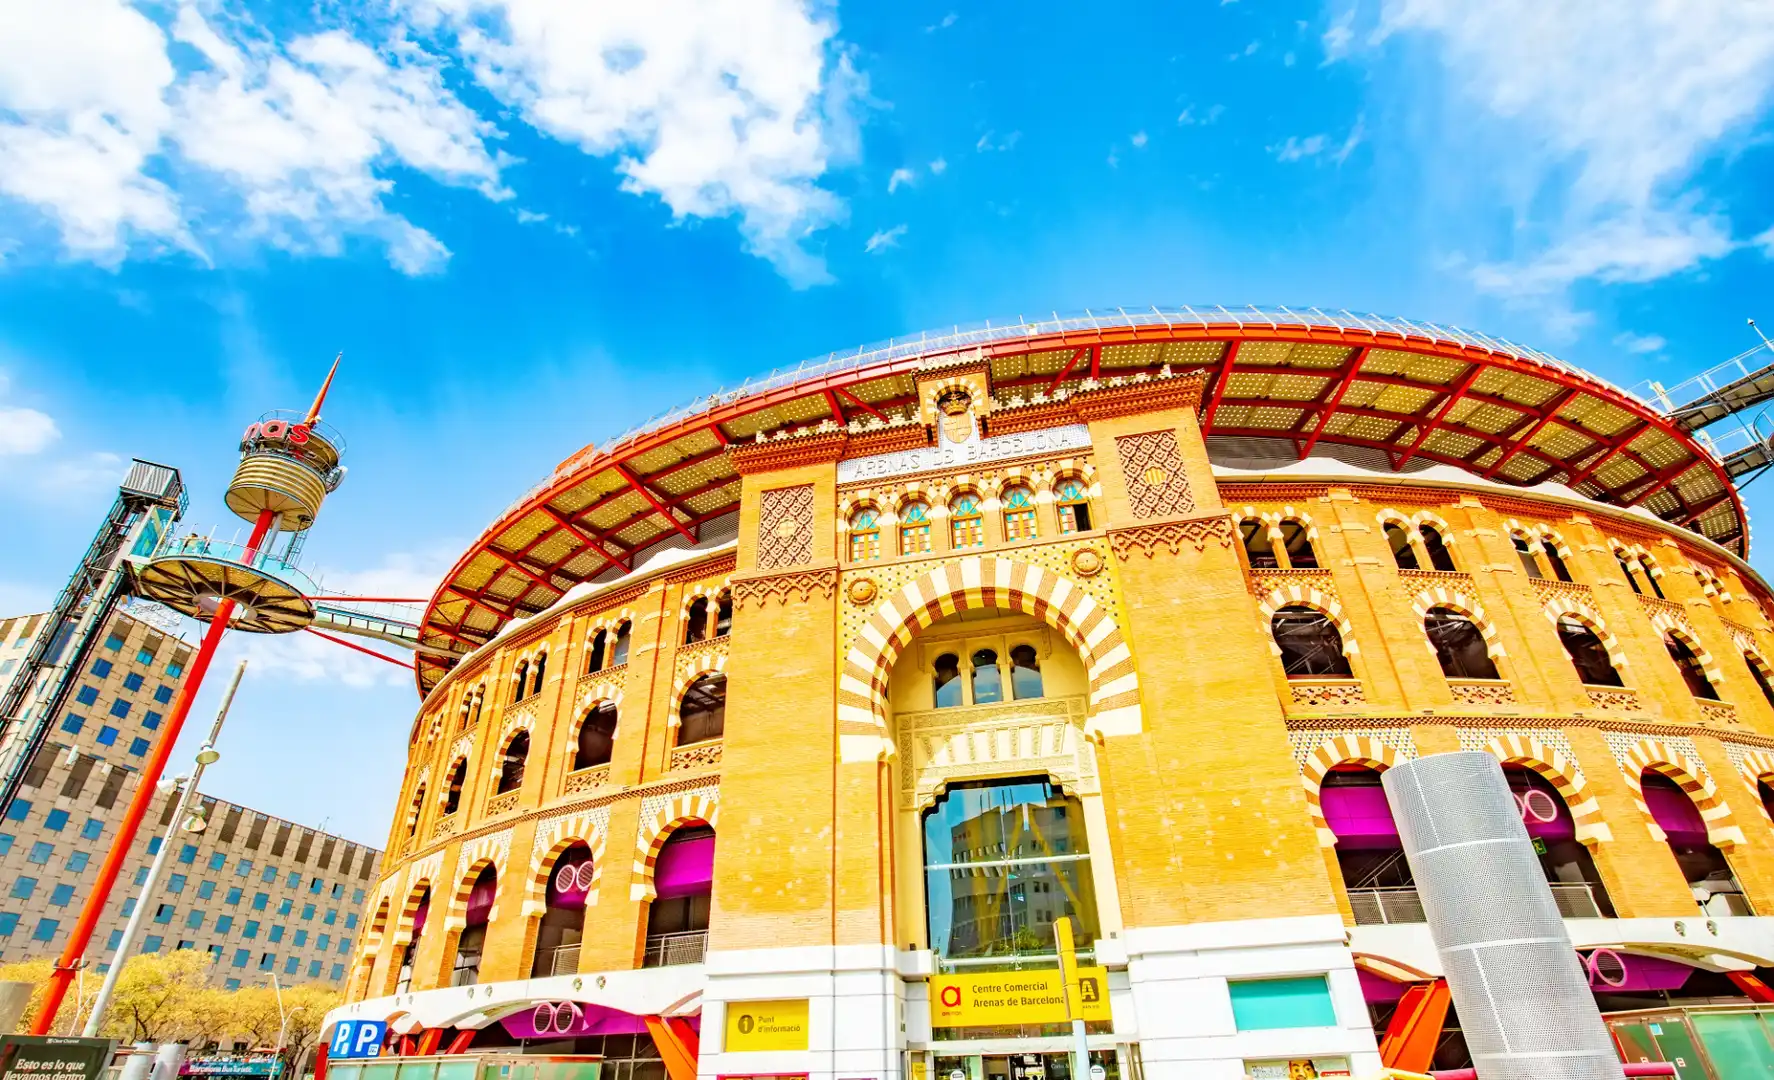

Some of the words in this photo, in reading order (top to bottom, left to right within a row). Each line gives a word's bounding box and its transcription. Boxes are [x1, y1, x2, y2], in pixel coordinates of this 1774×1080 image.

[854, 454, 920, 478] ARENAS
[933, 449, 954, 466] DE
[967, 433, 1072, 462] BARCELONA
[972, 984, 1002, 994] Centre
[1004, 982, 1048, 992] Comercial
[973, 998, 1005, 1008] Arenas
[1007, 997, 1018, 1007] de
[333, 1023, 351, 1052] P
[355, 1024, 378, 1052] P
[15, 1058, 40, 1070] Esto
[41, 1061, 53, 1070] es
[53, 1059, 64, 1070] lo
[65, 1061, 86, 1072] que
[189, 1064, 221, 1073] Barcelona
[221, 1064, 232, 1073] Bus
[3, 1070, 53, 1080] llevamos
[53, 1072, 86, 1080] dentro
